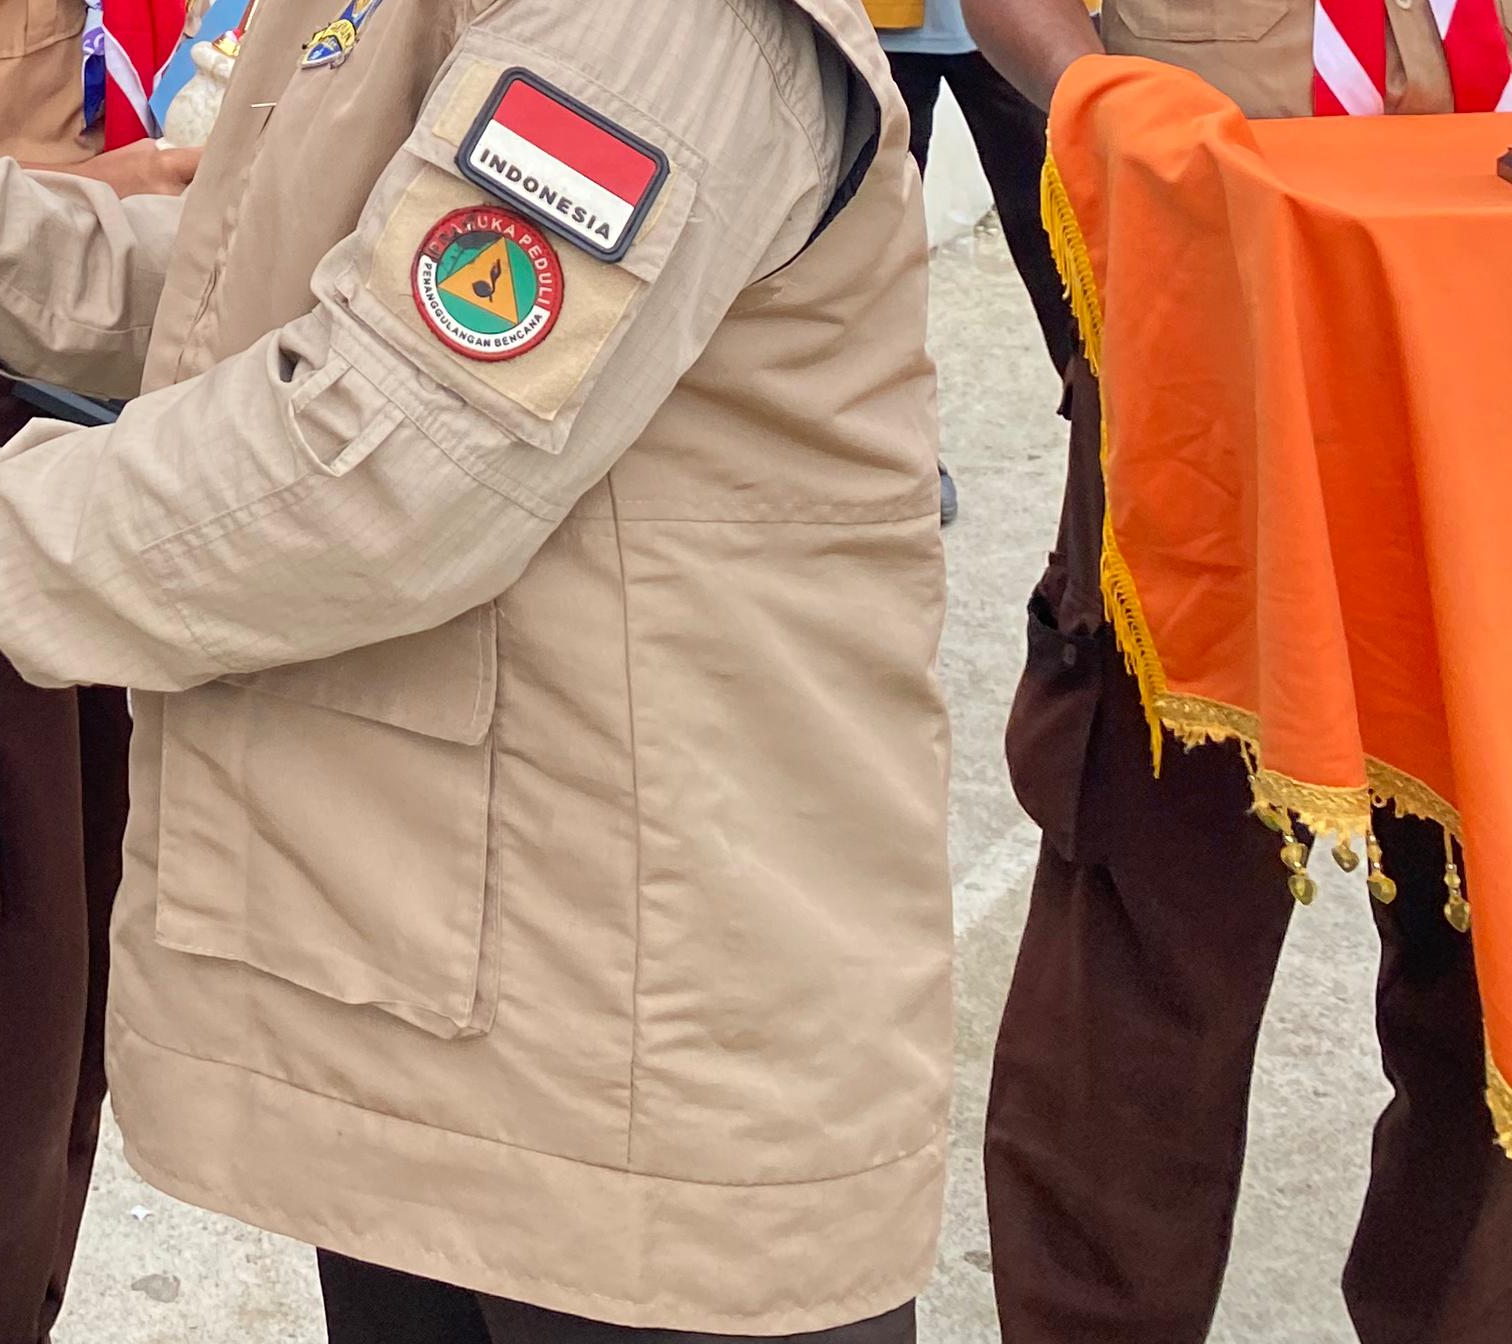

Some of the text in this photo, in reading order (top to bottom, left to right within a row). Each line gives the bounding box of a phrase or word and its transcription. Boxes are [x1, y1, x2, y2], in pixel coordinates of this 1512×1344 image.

[479, 147, 612, 242] INDONESIA
[422, 261, 544, 348] PENANGGULANGAN BENCANA
[518, 233, 554, 306] PEDULI
